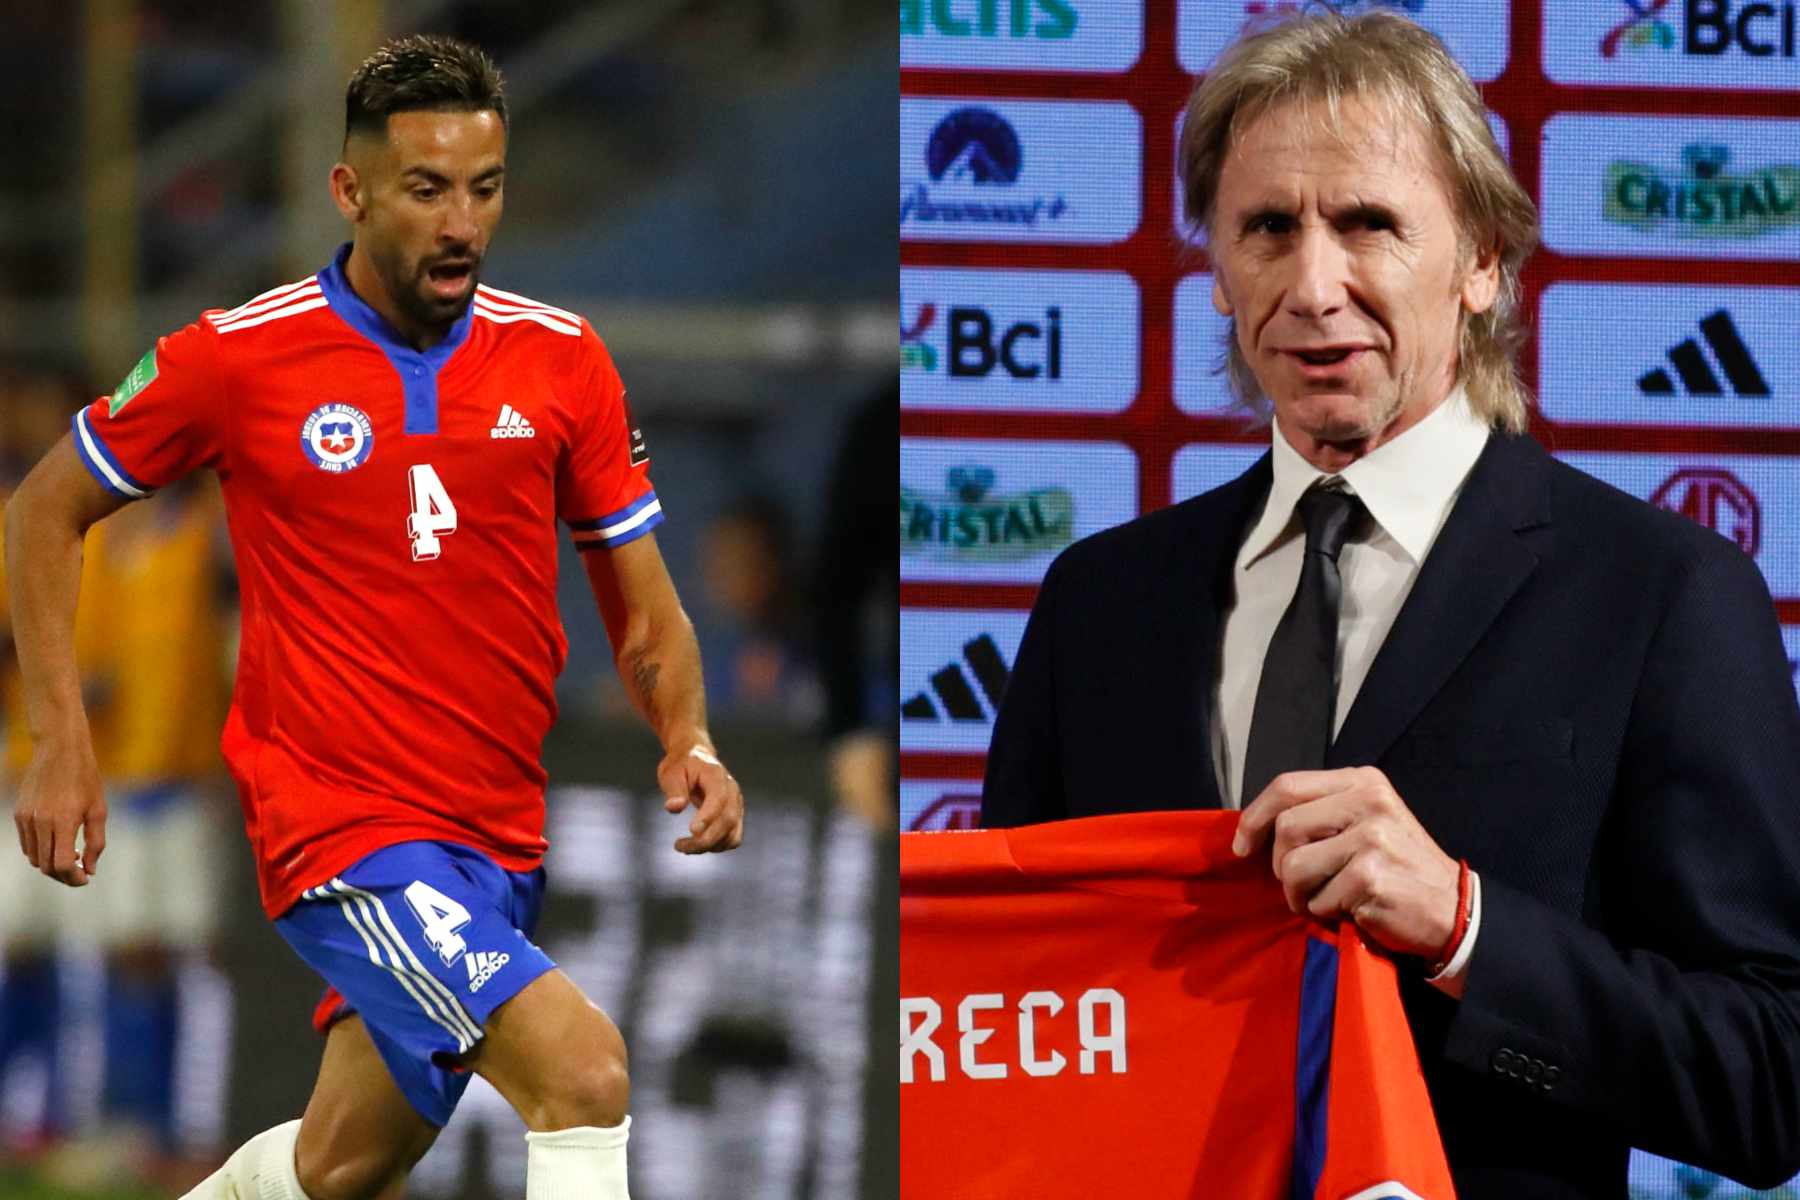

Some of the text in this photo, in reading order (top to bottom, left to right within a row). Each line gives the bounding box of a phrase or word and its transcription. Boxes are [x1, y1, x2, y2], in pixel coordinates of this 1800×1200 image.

[949, 305, 1062, 379] Bci
[900, 494, 1063, 547] RISTAL
[900, 988, 1128, 1083] RECA
